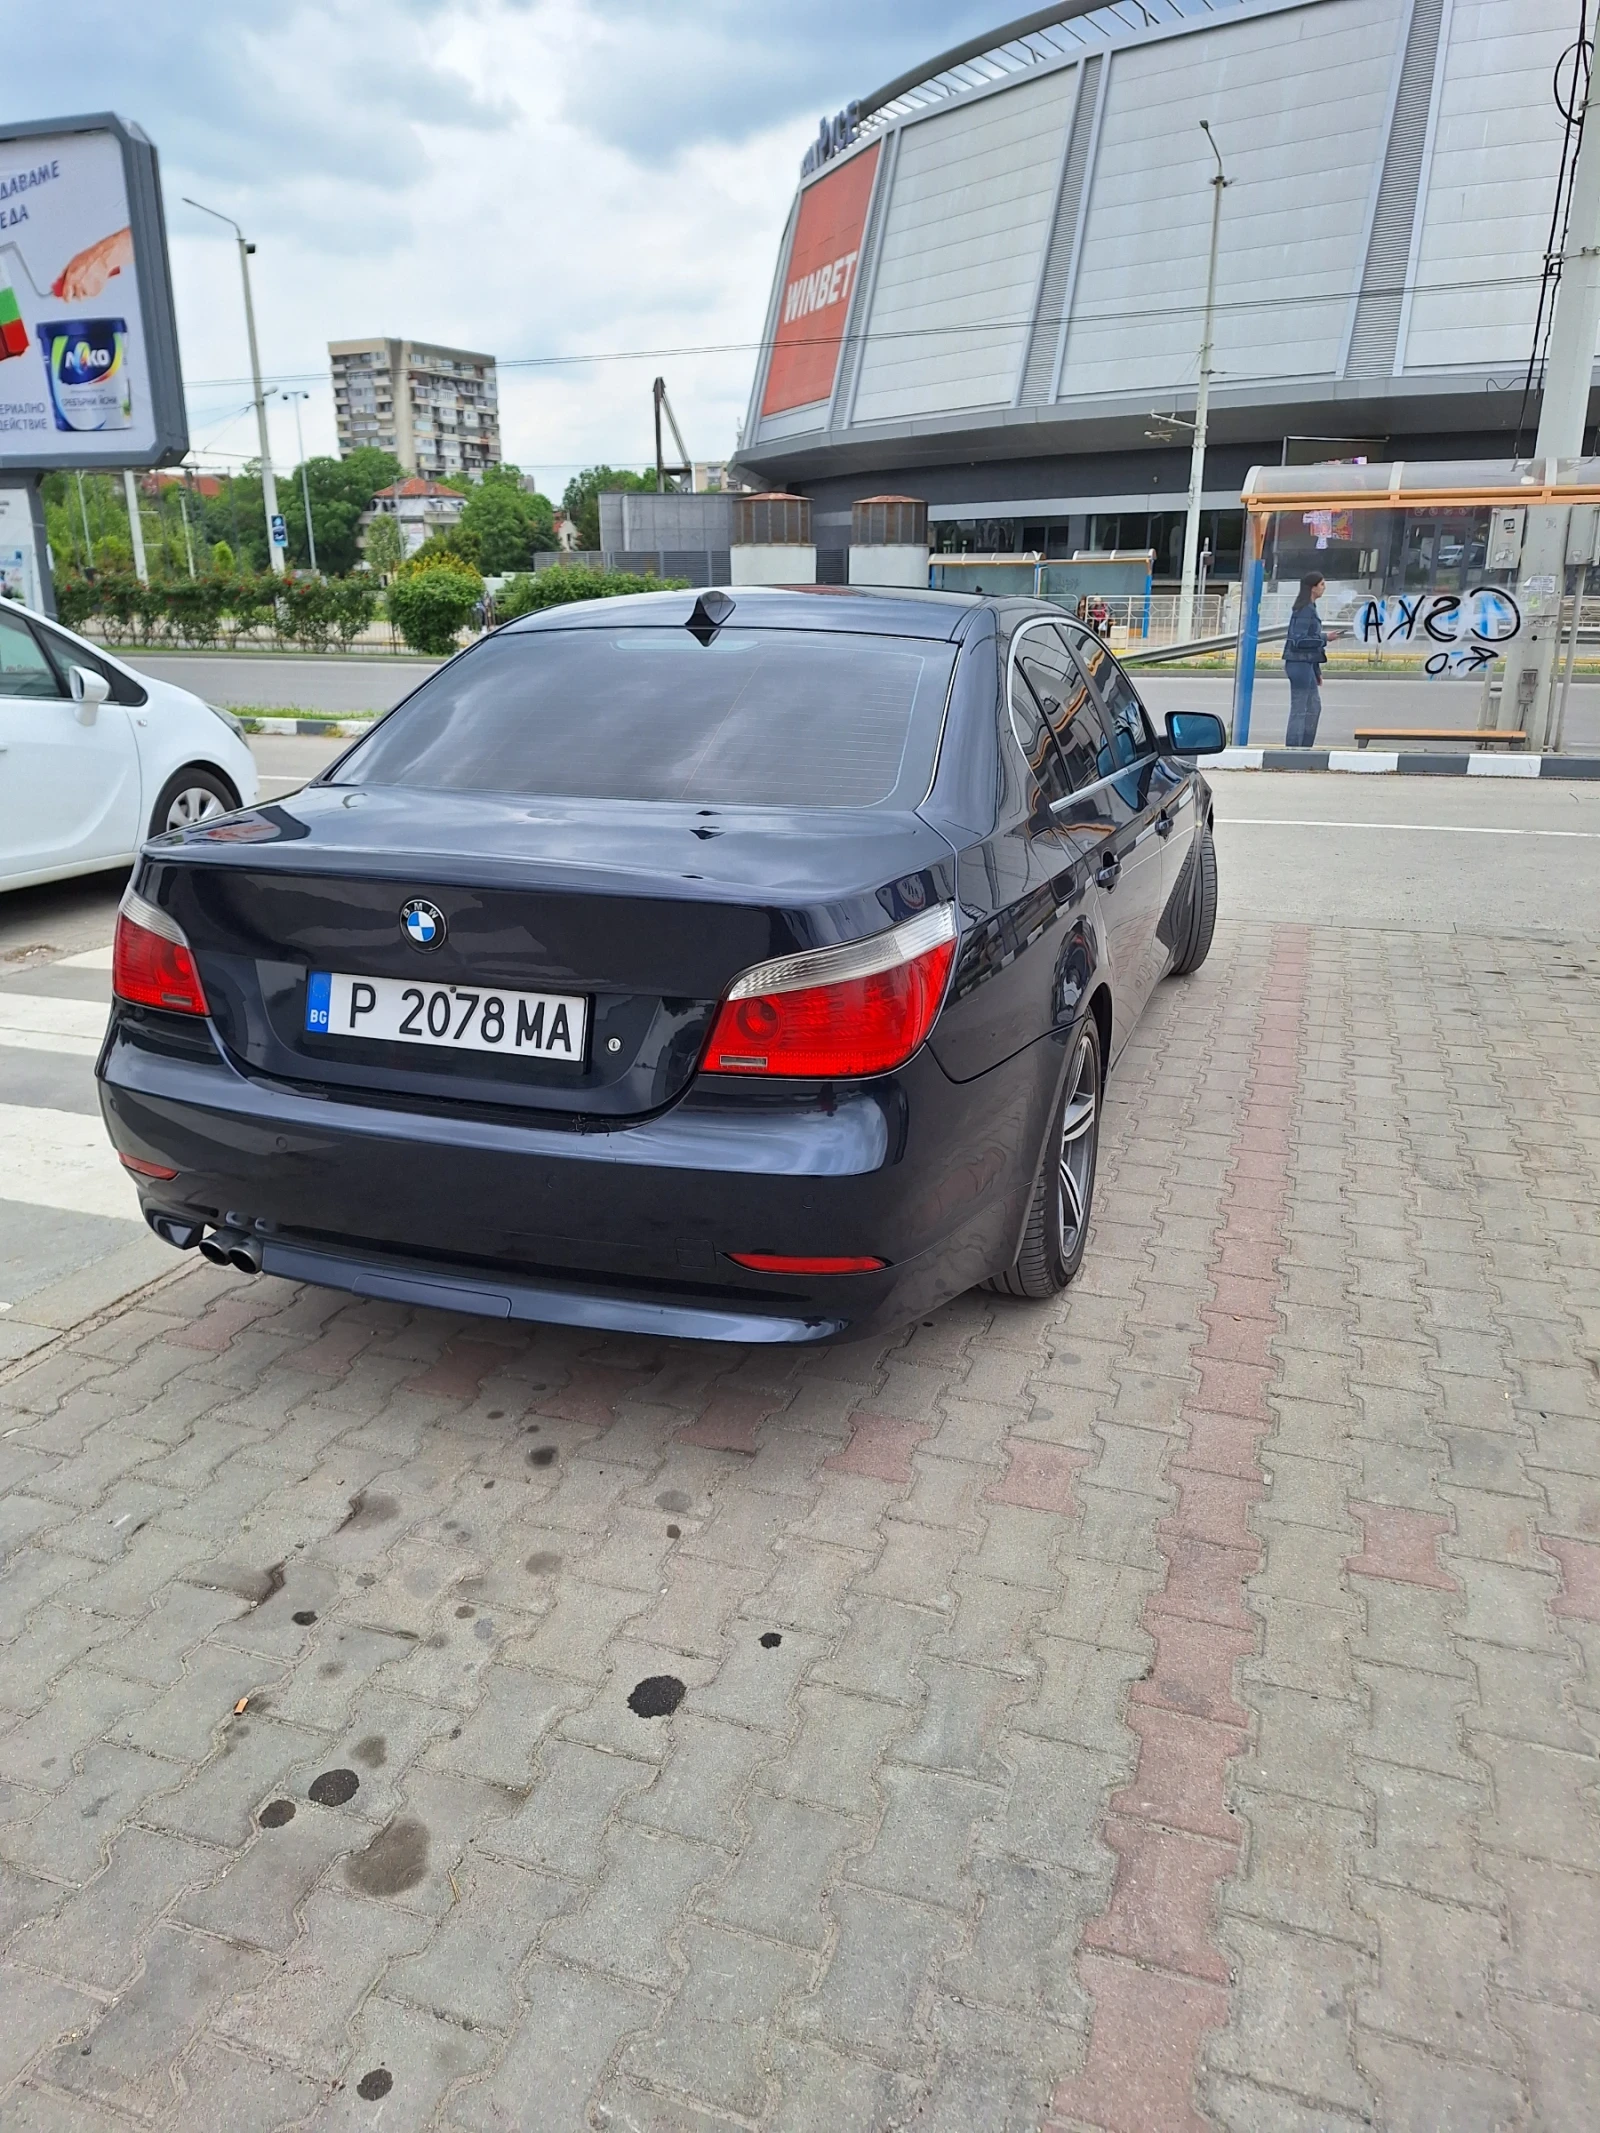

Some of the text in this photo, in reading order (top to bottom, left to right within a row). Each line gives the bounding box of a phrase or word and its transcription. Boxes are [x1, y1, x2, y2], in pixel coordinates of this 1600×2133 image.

[784, 251, 858, 324] WINBET
[402, 902, 440, 919] BMW
[310, 1009, 328, 1025] BG
[349, 982, 572, 1053] P 2078 MA
